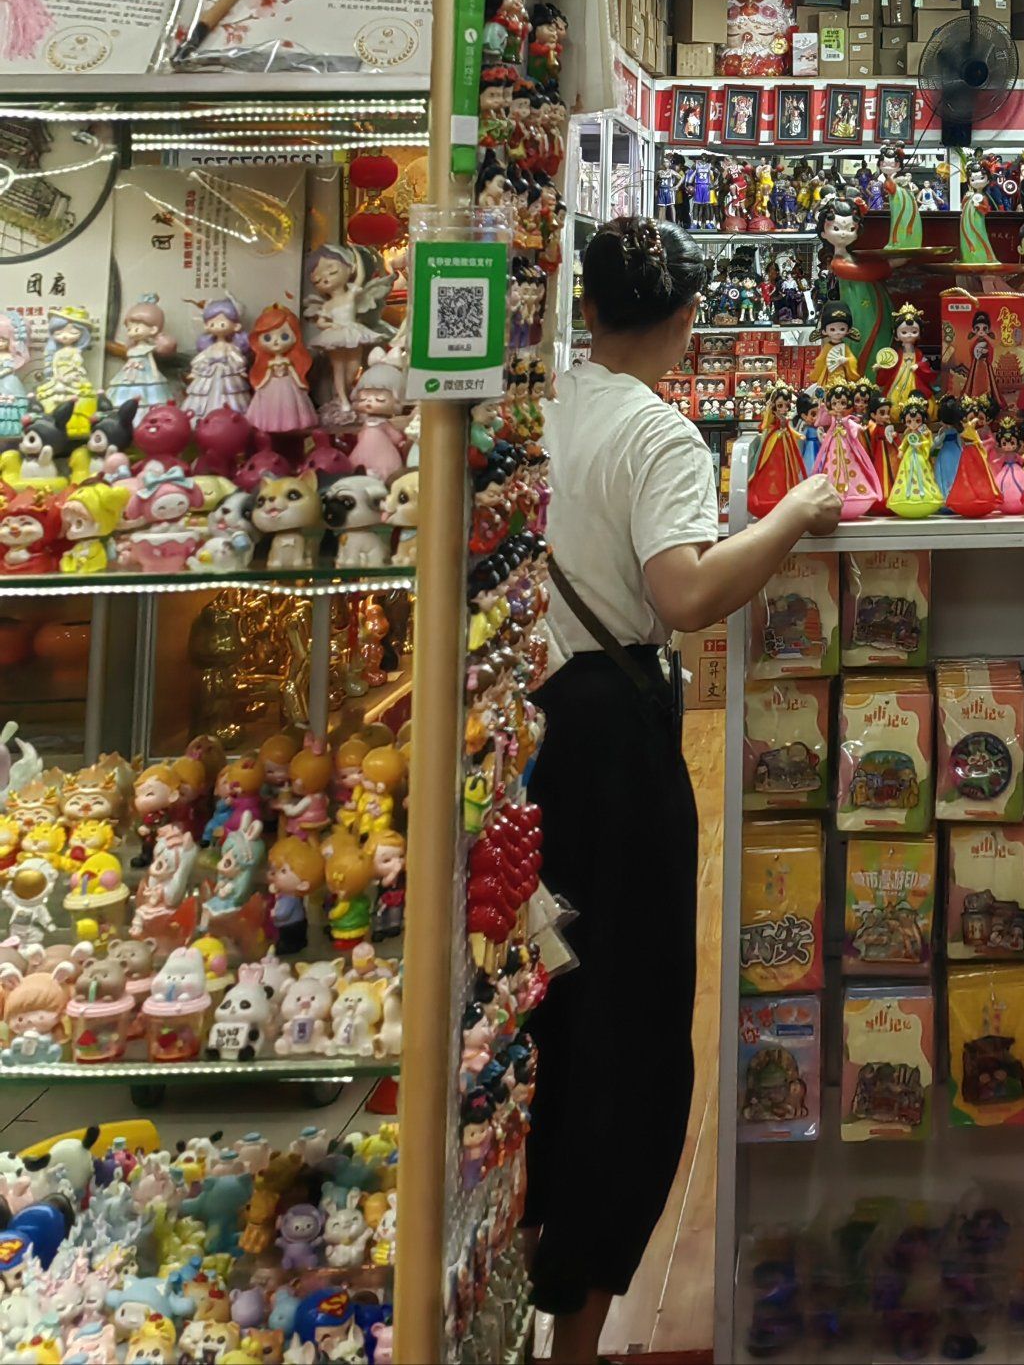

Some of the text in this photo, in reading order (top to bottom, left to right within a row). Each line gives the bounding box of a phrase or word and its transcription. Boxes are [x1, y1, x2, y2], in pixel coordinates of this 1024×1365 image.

[26, 272, 66, 297] 团扇
[443, 378, 485, 392] 微信支付
